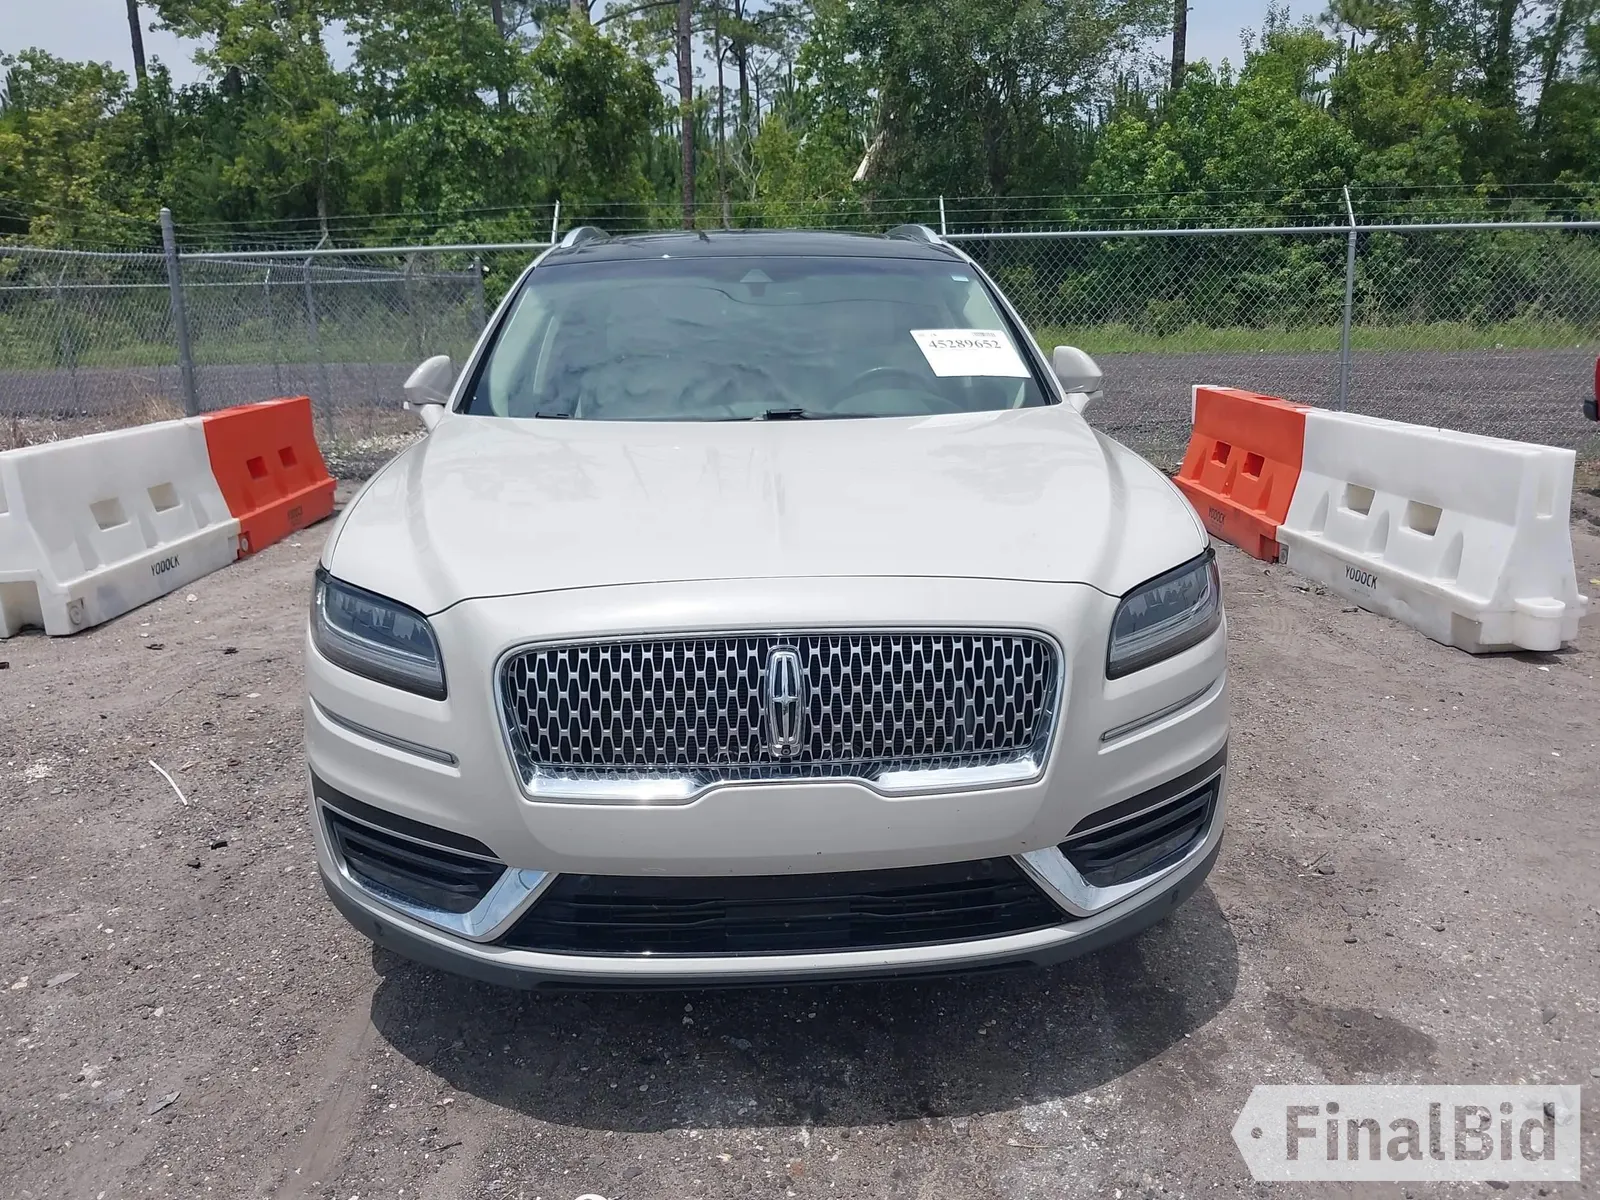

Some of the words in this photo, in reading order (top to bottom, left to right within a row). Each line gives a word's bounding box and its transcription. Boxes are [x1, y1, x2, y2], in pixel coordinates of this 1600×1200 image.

[928, 339, 1002, 349] 45289652
[150, 554, 180, 577] YODOCK
[1344, 564, 1378, 590] YODOCK
